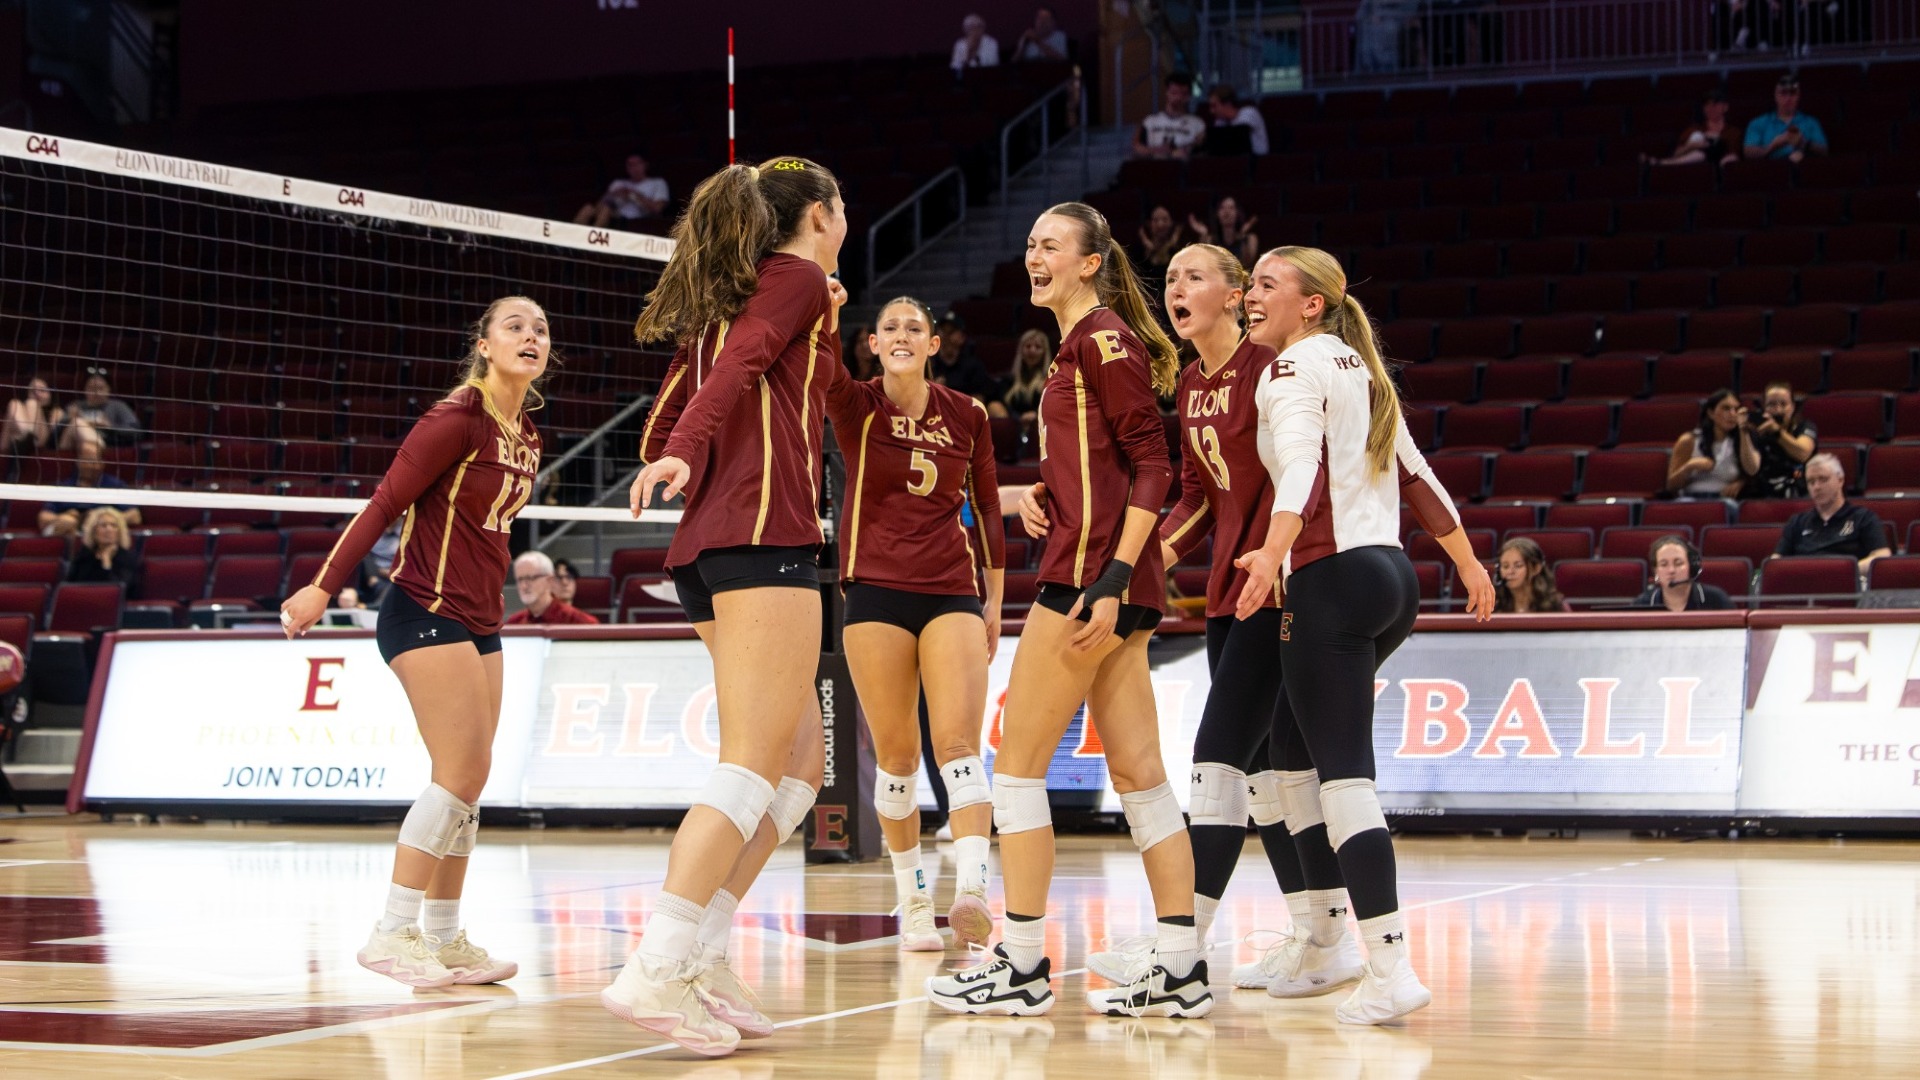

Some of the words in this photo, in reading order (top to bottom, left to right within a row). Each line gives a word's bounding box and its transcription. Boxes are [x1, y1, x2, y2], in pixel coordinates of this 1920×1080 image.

[26, 135, 60, 157] CAA
[115, 149, 151, 172] ELON
[153, 156, 233, 187] VOLLEYBALL
[282, 178, 291, 196] E
[338, 188, 365, 208] CAA
[543, 222, 551, 237] E
[587, 229, 610, 247] CAA
[1089, 329, 1129, 366] E
[1333, 354, 1364, 370] PHO
[1269, 359, 1296, 383] E
[1186, 385, 1232, 419] ELON
[906, 447, 939, 497] 5
[1188, 425, 1231, 491] 13
[482, 471, 532, 534] 12
[298, 656, 346, 712] E
[1803, 631, 1871, 703] E
[543, 682, 720, 757] ELO
[819, 678, 836, 728] sports
[1838, 743, 1900, 761] THE
[222, 766, 283, 788] JOIN
[292, 766, 386, 788] TODAY!
[810, 804, 850, 850] E
